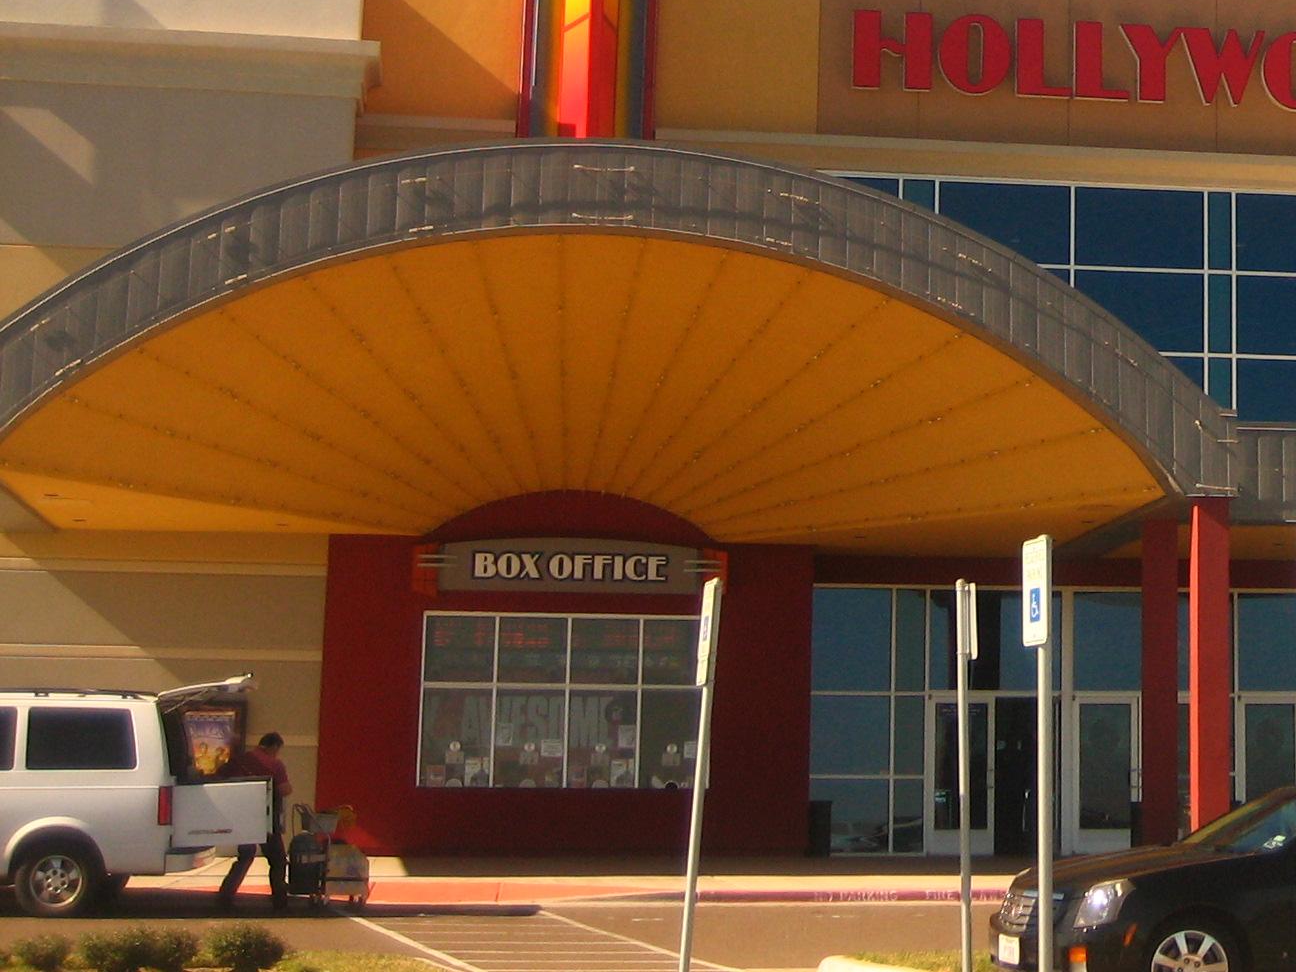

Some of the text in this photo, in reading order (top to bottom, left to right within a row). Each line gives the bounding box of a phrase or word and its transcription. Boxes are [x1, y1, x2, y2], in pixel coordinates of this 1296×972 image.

[474, 552, 667, 581] BOX OFFICE
[840, 890, 898, 901] PARKING
